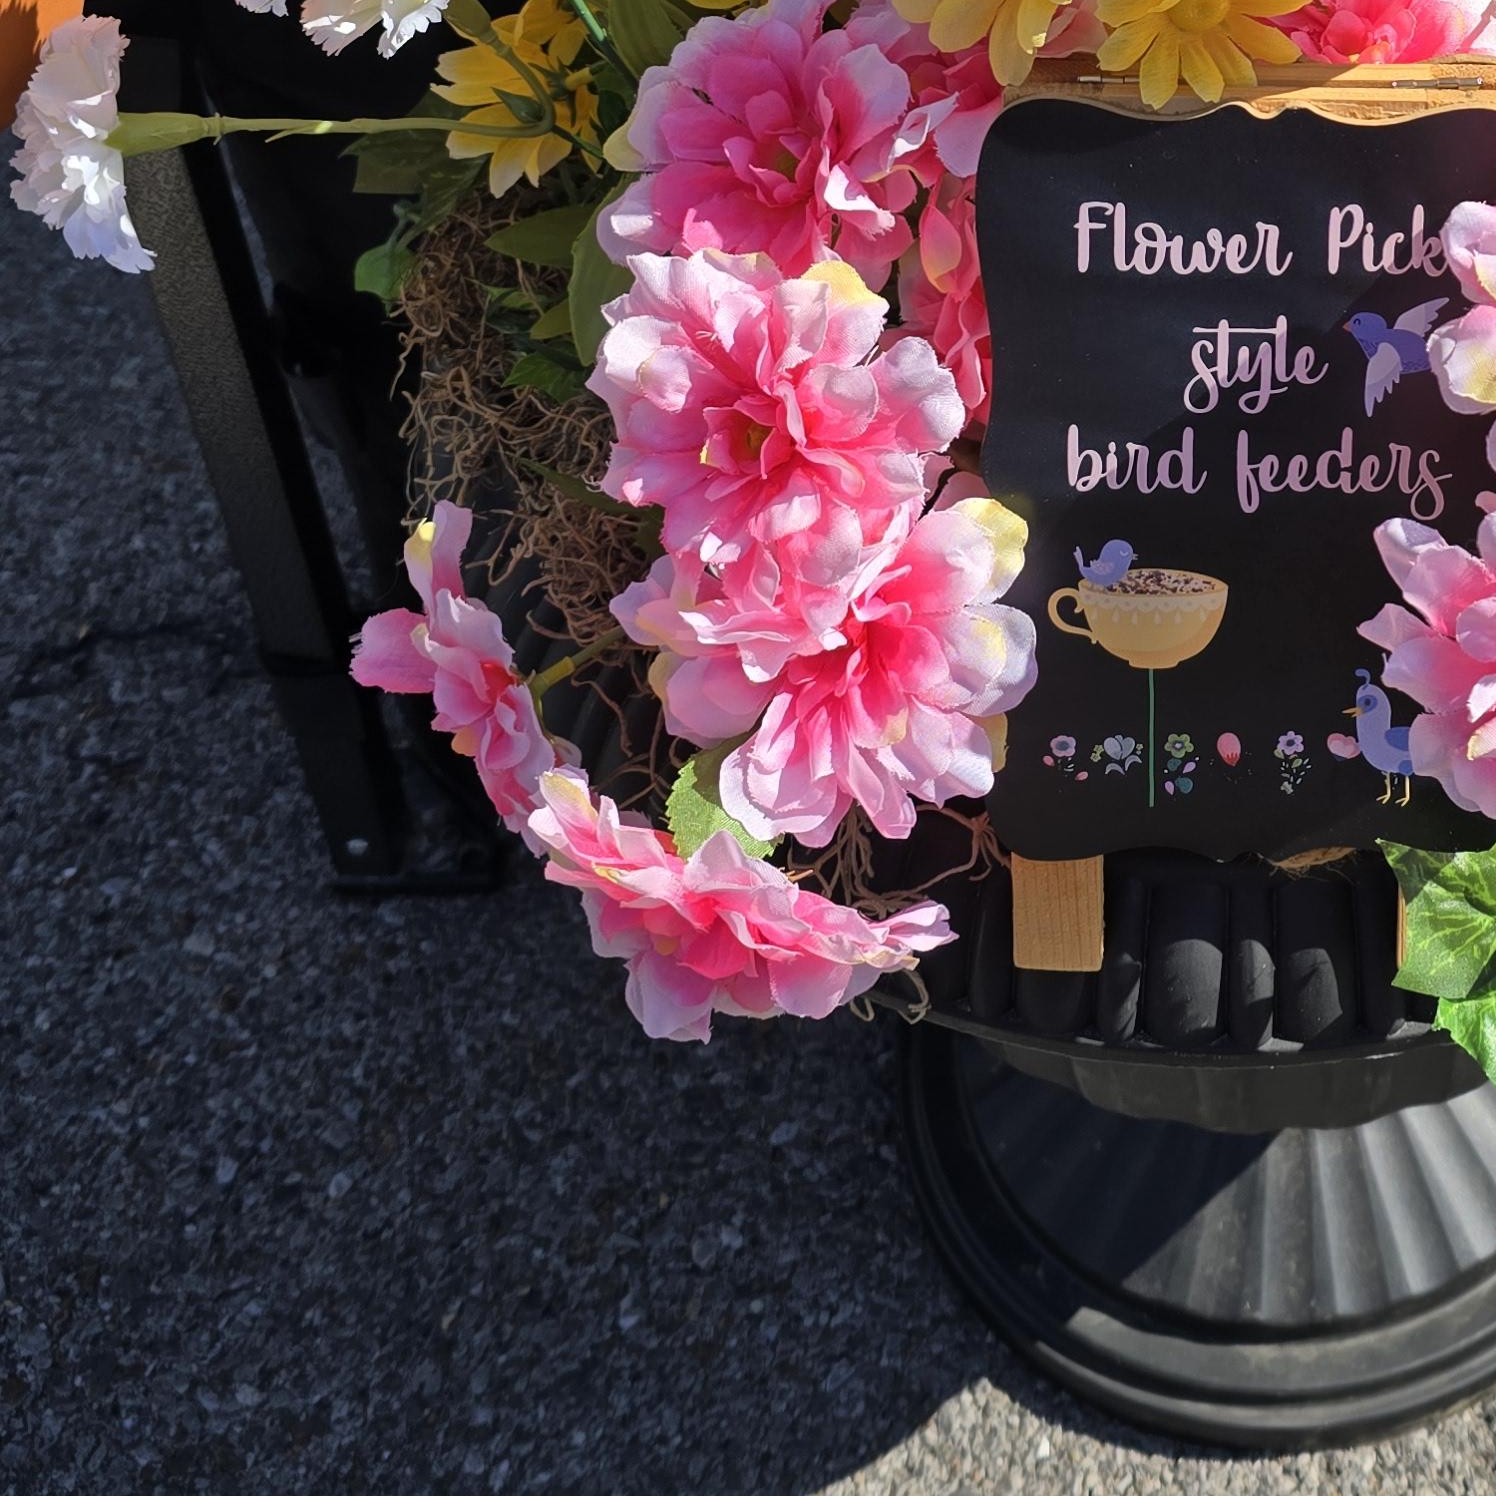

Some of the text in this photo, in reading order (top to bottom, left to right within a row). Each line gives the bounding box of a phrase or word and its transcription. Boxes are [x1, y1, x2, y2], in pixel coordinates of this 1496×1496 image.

[1073, 201, 1449, 276] Flower Pick
[1184, 315, 1328, 414] style
[1067, 424, 1453, 520] bird feeders
